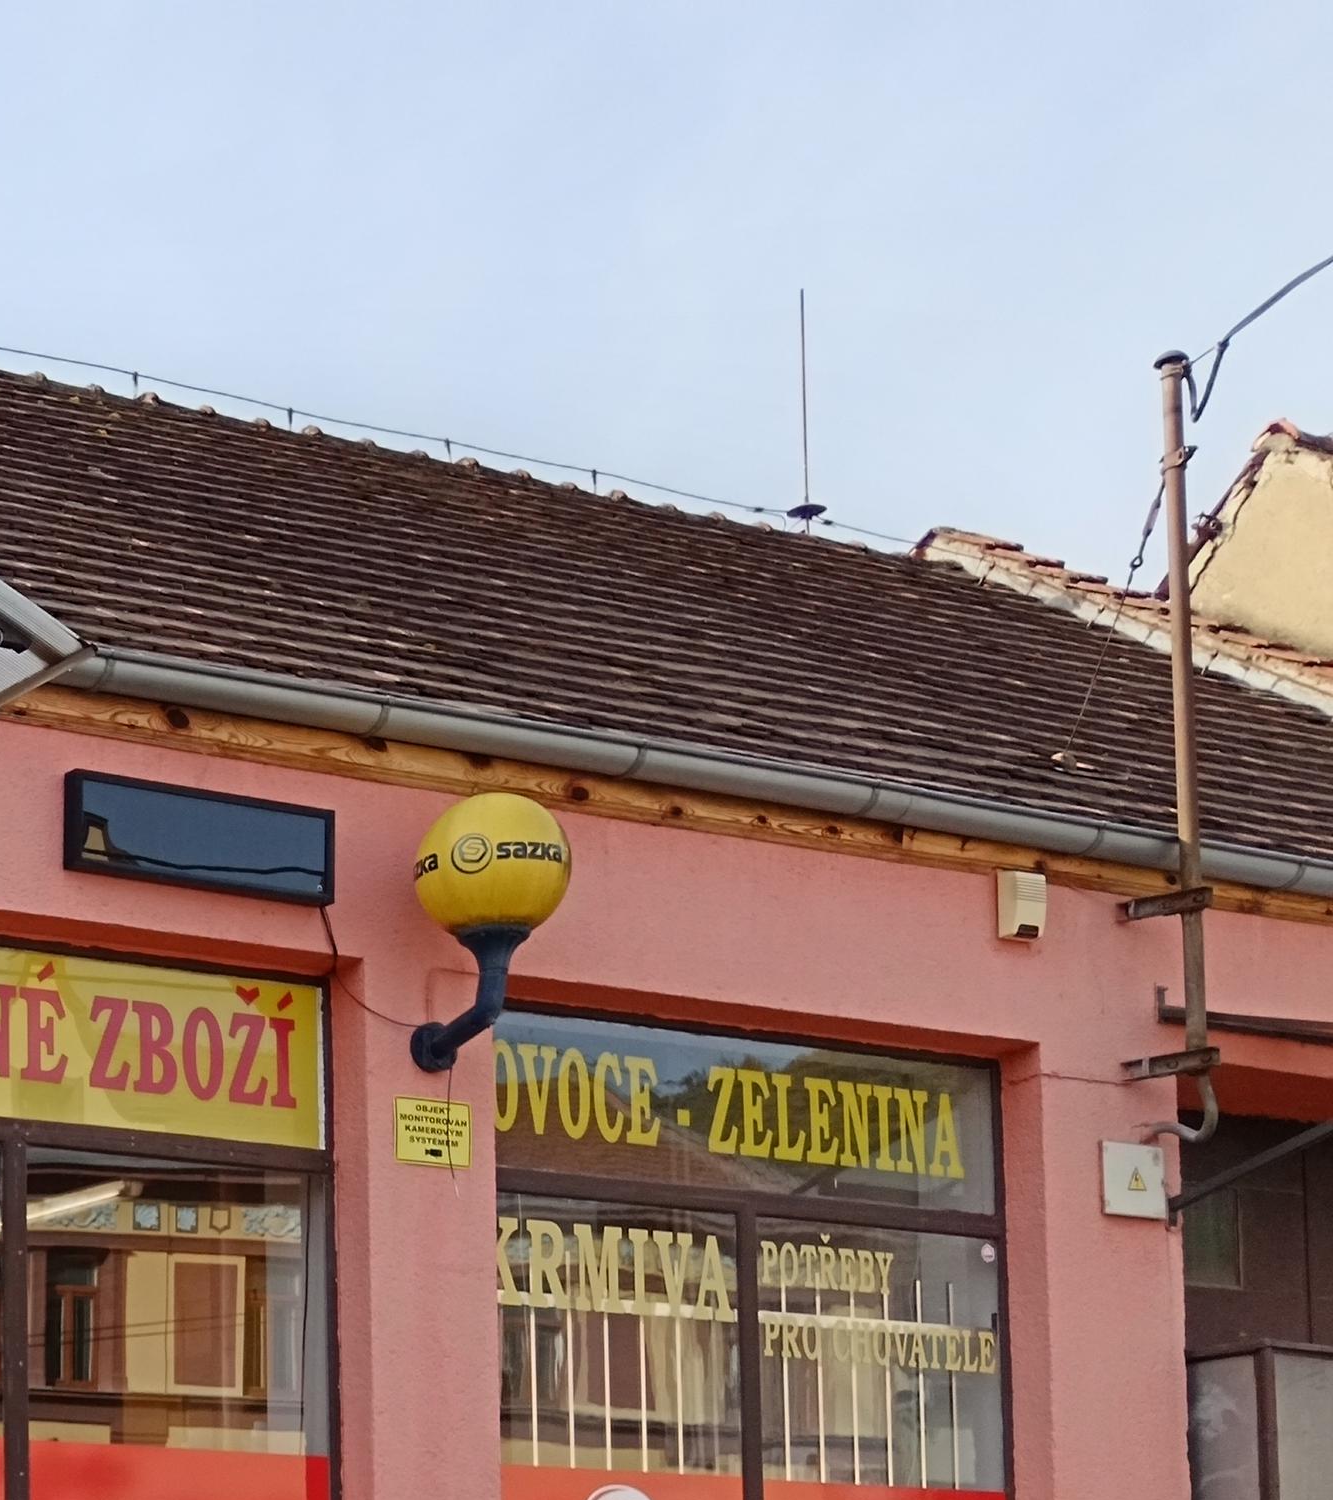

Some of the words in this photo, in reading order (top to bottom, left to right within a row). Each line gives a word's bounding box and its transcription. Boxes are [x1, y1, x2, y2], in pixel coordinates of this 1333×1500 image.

[88, 984, 297, 1110] ZBOŽÍ
[415, 1104, 451, 1114] OBJEKT
[493, 1039, 661, 1148] OVOCE
[706, 1066, 965, 1180] ZELENINA
[760, 1233, 894, 1296] POTŘEBY
[762, 1315, 822, 1361] PRO
